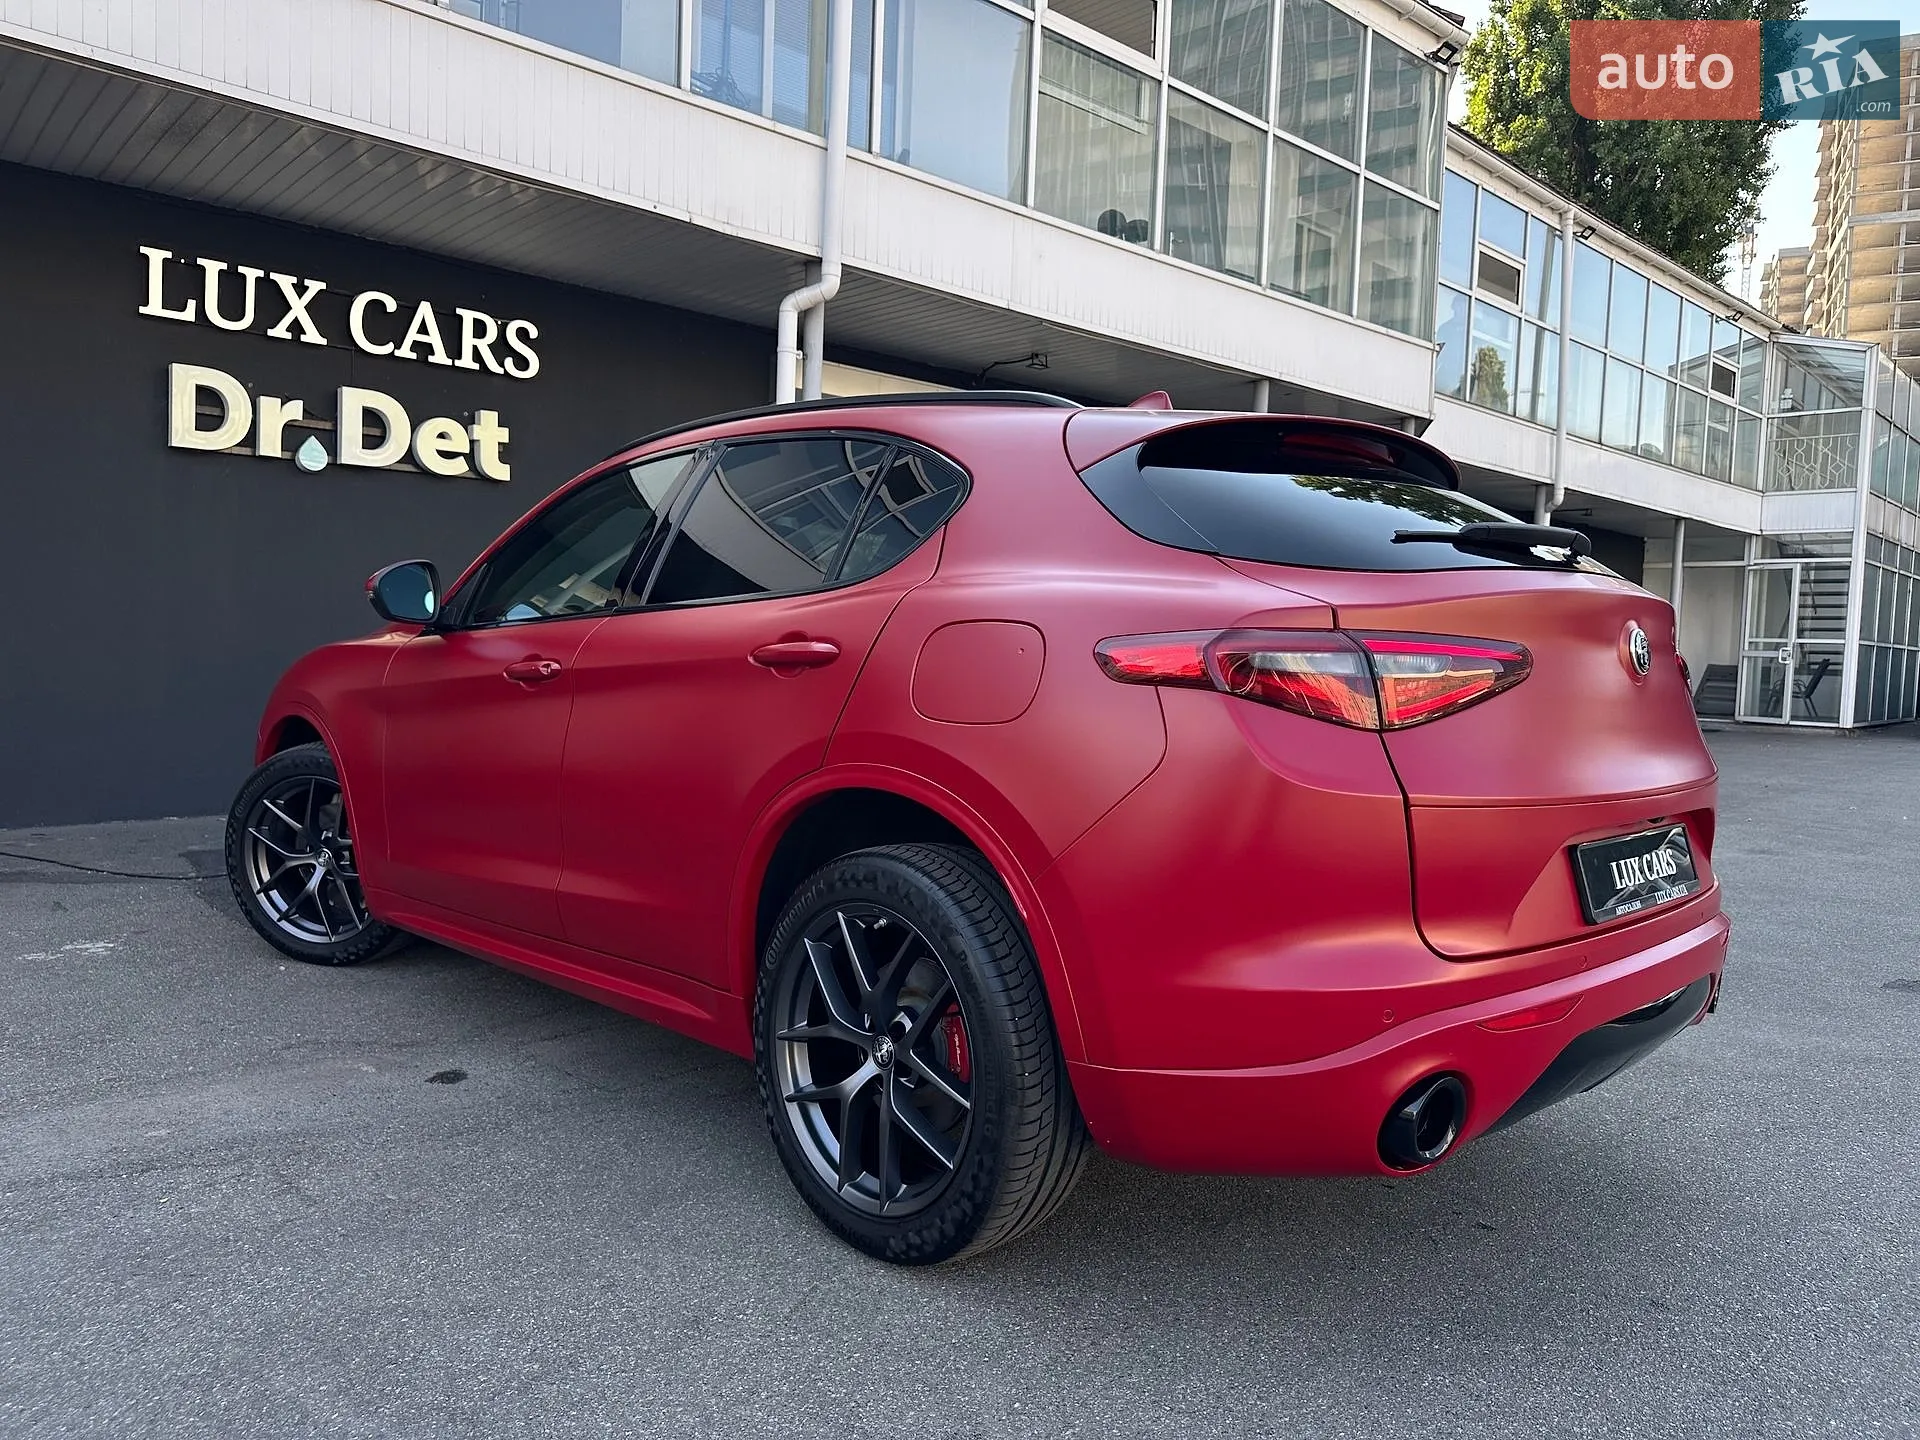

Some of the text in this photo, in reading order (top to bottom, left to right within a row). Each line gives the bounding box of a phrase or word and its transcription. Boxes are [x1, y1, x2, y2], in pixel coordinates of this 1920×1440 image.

[138, 245, 541, 380] LUX CARS
[1610, 848, 1677, 889] LUX CARS
